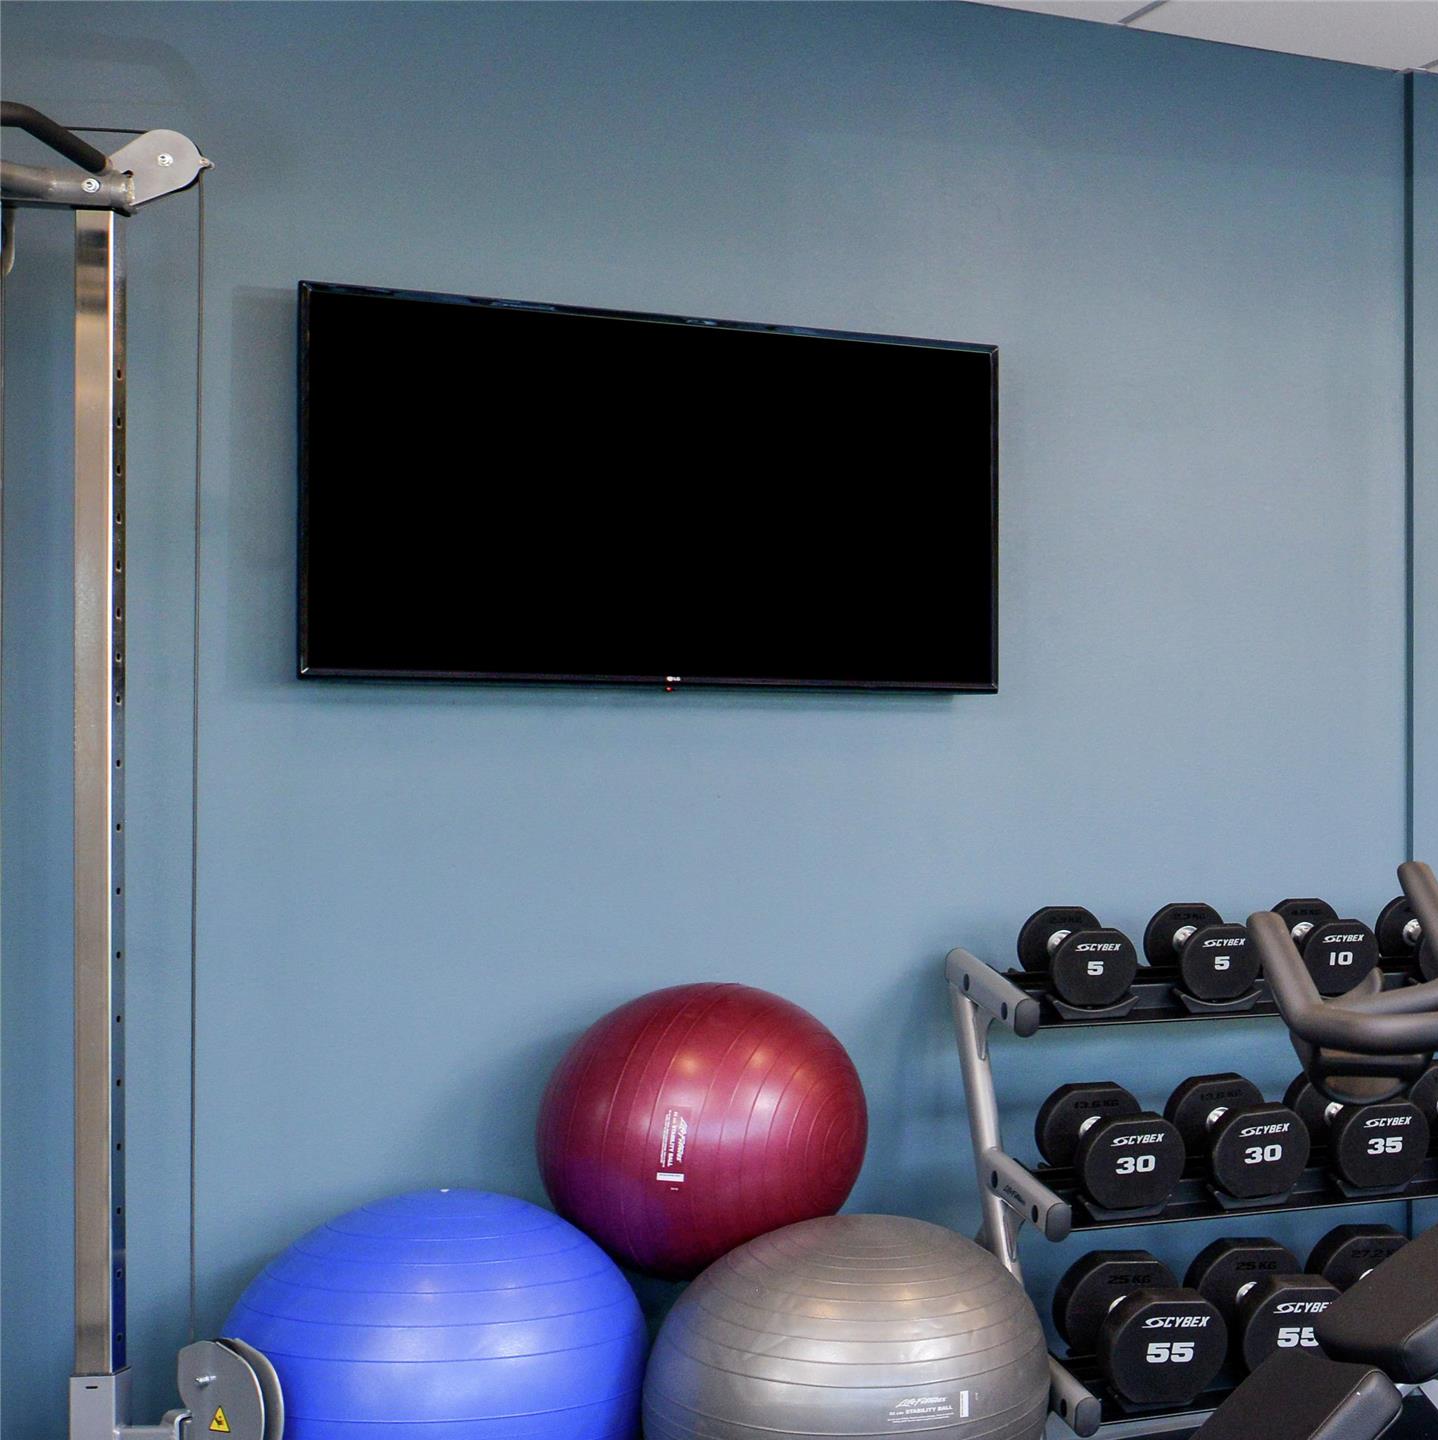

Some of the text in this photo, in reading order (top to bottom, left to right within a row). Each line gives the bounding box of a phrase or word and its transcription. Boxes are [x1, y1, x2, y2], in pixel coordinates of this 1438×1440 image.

[1215, 938, 1246, 947] CYBEX
[1335, 934, 1365, 943] CYBEX
[1089, 943, 1121, 951] CYBEX
[1214, 956, 1230, 971] 5
[1329, 952, 1353, 966] 10
[1087, 961, 1104, 976] 5
[1378, 1116, 1412, 1127] CYBEX
[1255, 1123, 1290, 1135] CYBEX
[1127, 1133, 1165, 1145] CYBEX
[1367, 1136, 1403, 1155] 35
[1244, 1144, 1283, 1164] 30
[1115, 1155, 1156, 1175] 30
[1163, 1316, 1211, 1328] CYBEX
[1276, 1327, 1320, 1348] 55
[1145, 1341, 1195, 1364] 55
